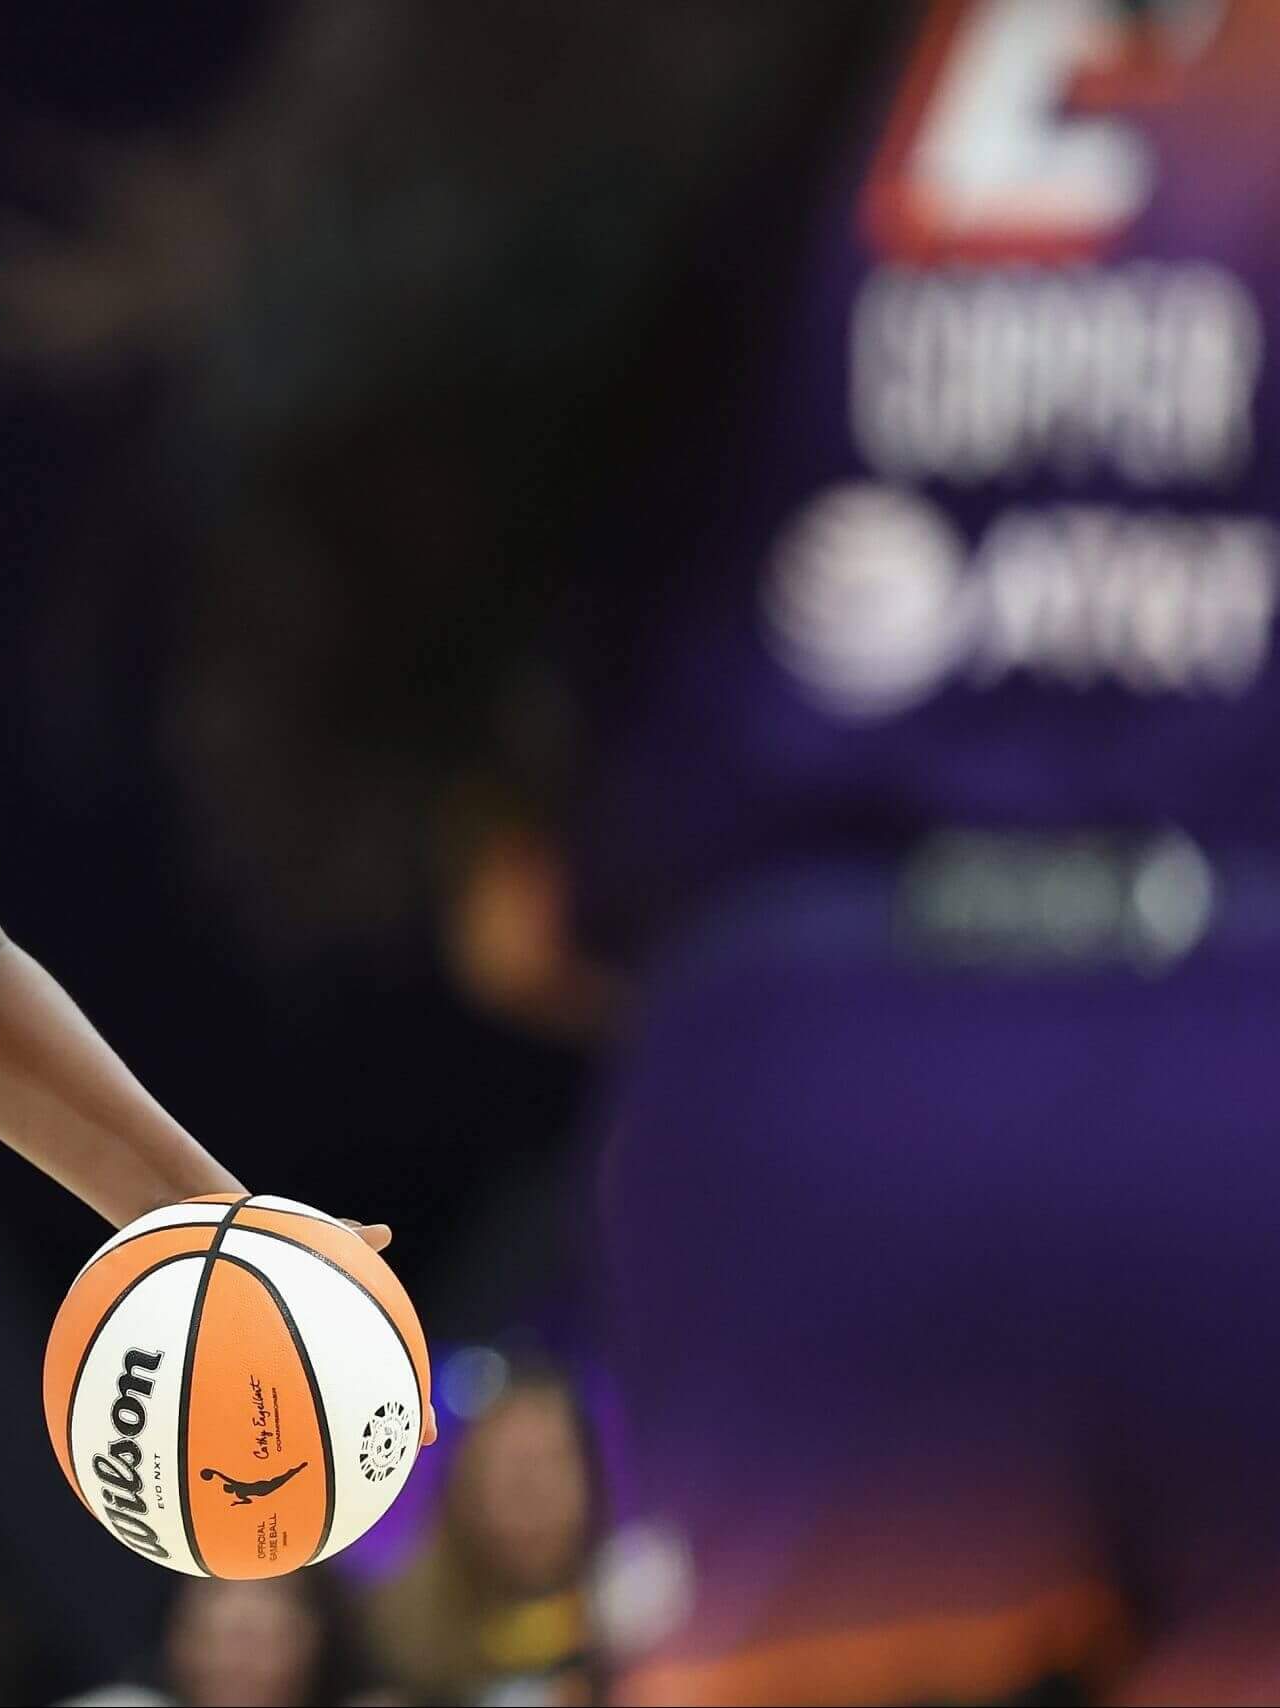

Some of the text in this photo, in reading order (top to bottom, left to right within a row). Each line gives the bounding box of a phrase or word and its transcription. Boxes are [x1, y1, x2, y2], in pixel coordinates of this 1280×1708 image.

[92, 1346, 172, 1560] Wilson
[154, 1453, 165, 1509] EVO NXT
